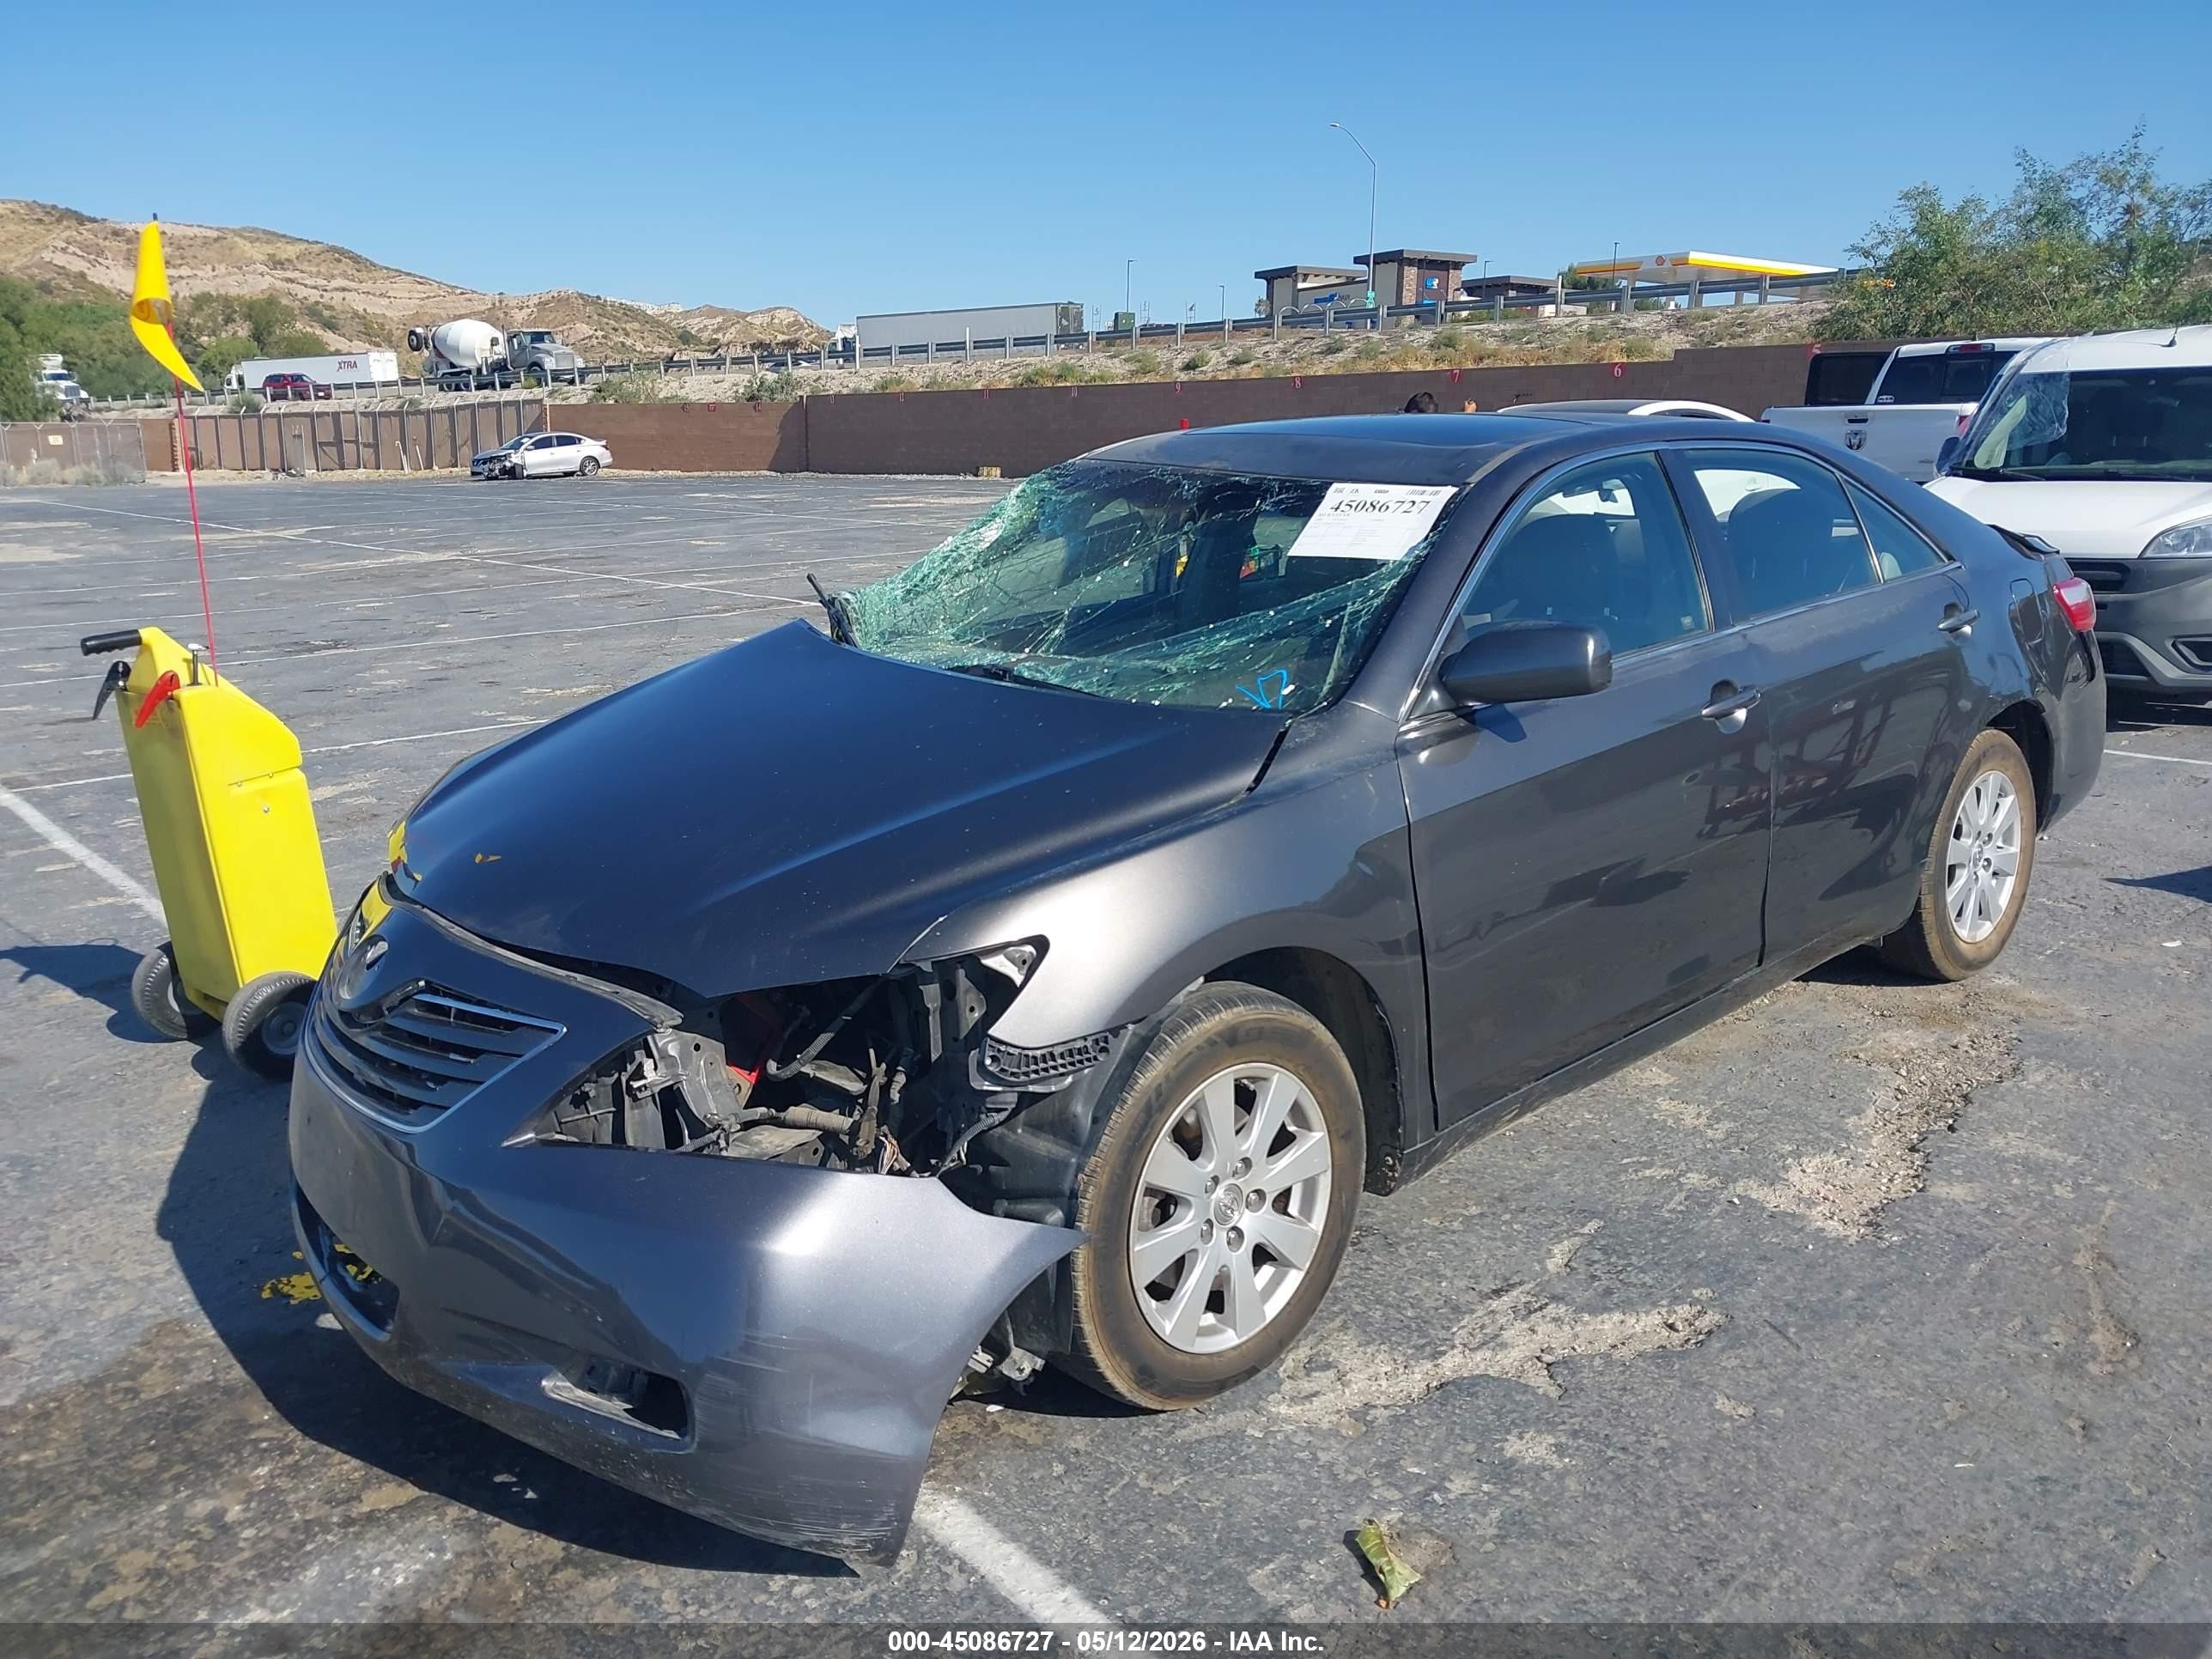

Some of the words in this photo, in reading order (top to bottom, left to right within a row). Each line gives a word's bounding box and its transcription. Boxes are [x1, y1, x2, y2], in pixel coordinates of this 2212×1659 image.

[336, 360, 358, 372] XTRA
[1614, 362, 1621, 377] 6
[1295, 376, 1302, 389] 8
[1452, 369, 1460, 383] 7
[1071, 386, 1079, 398] 10
[1176, 382, 1182, 393] 9
[1330, 499, 1431, 515] 45086727
